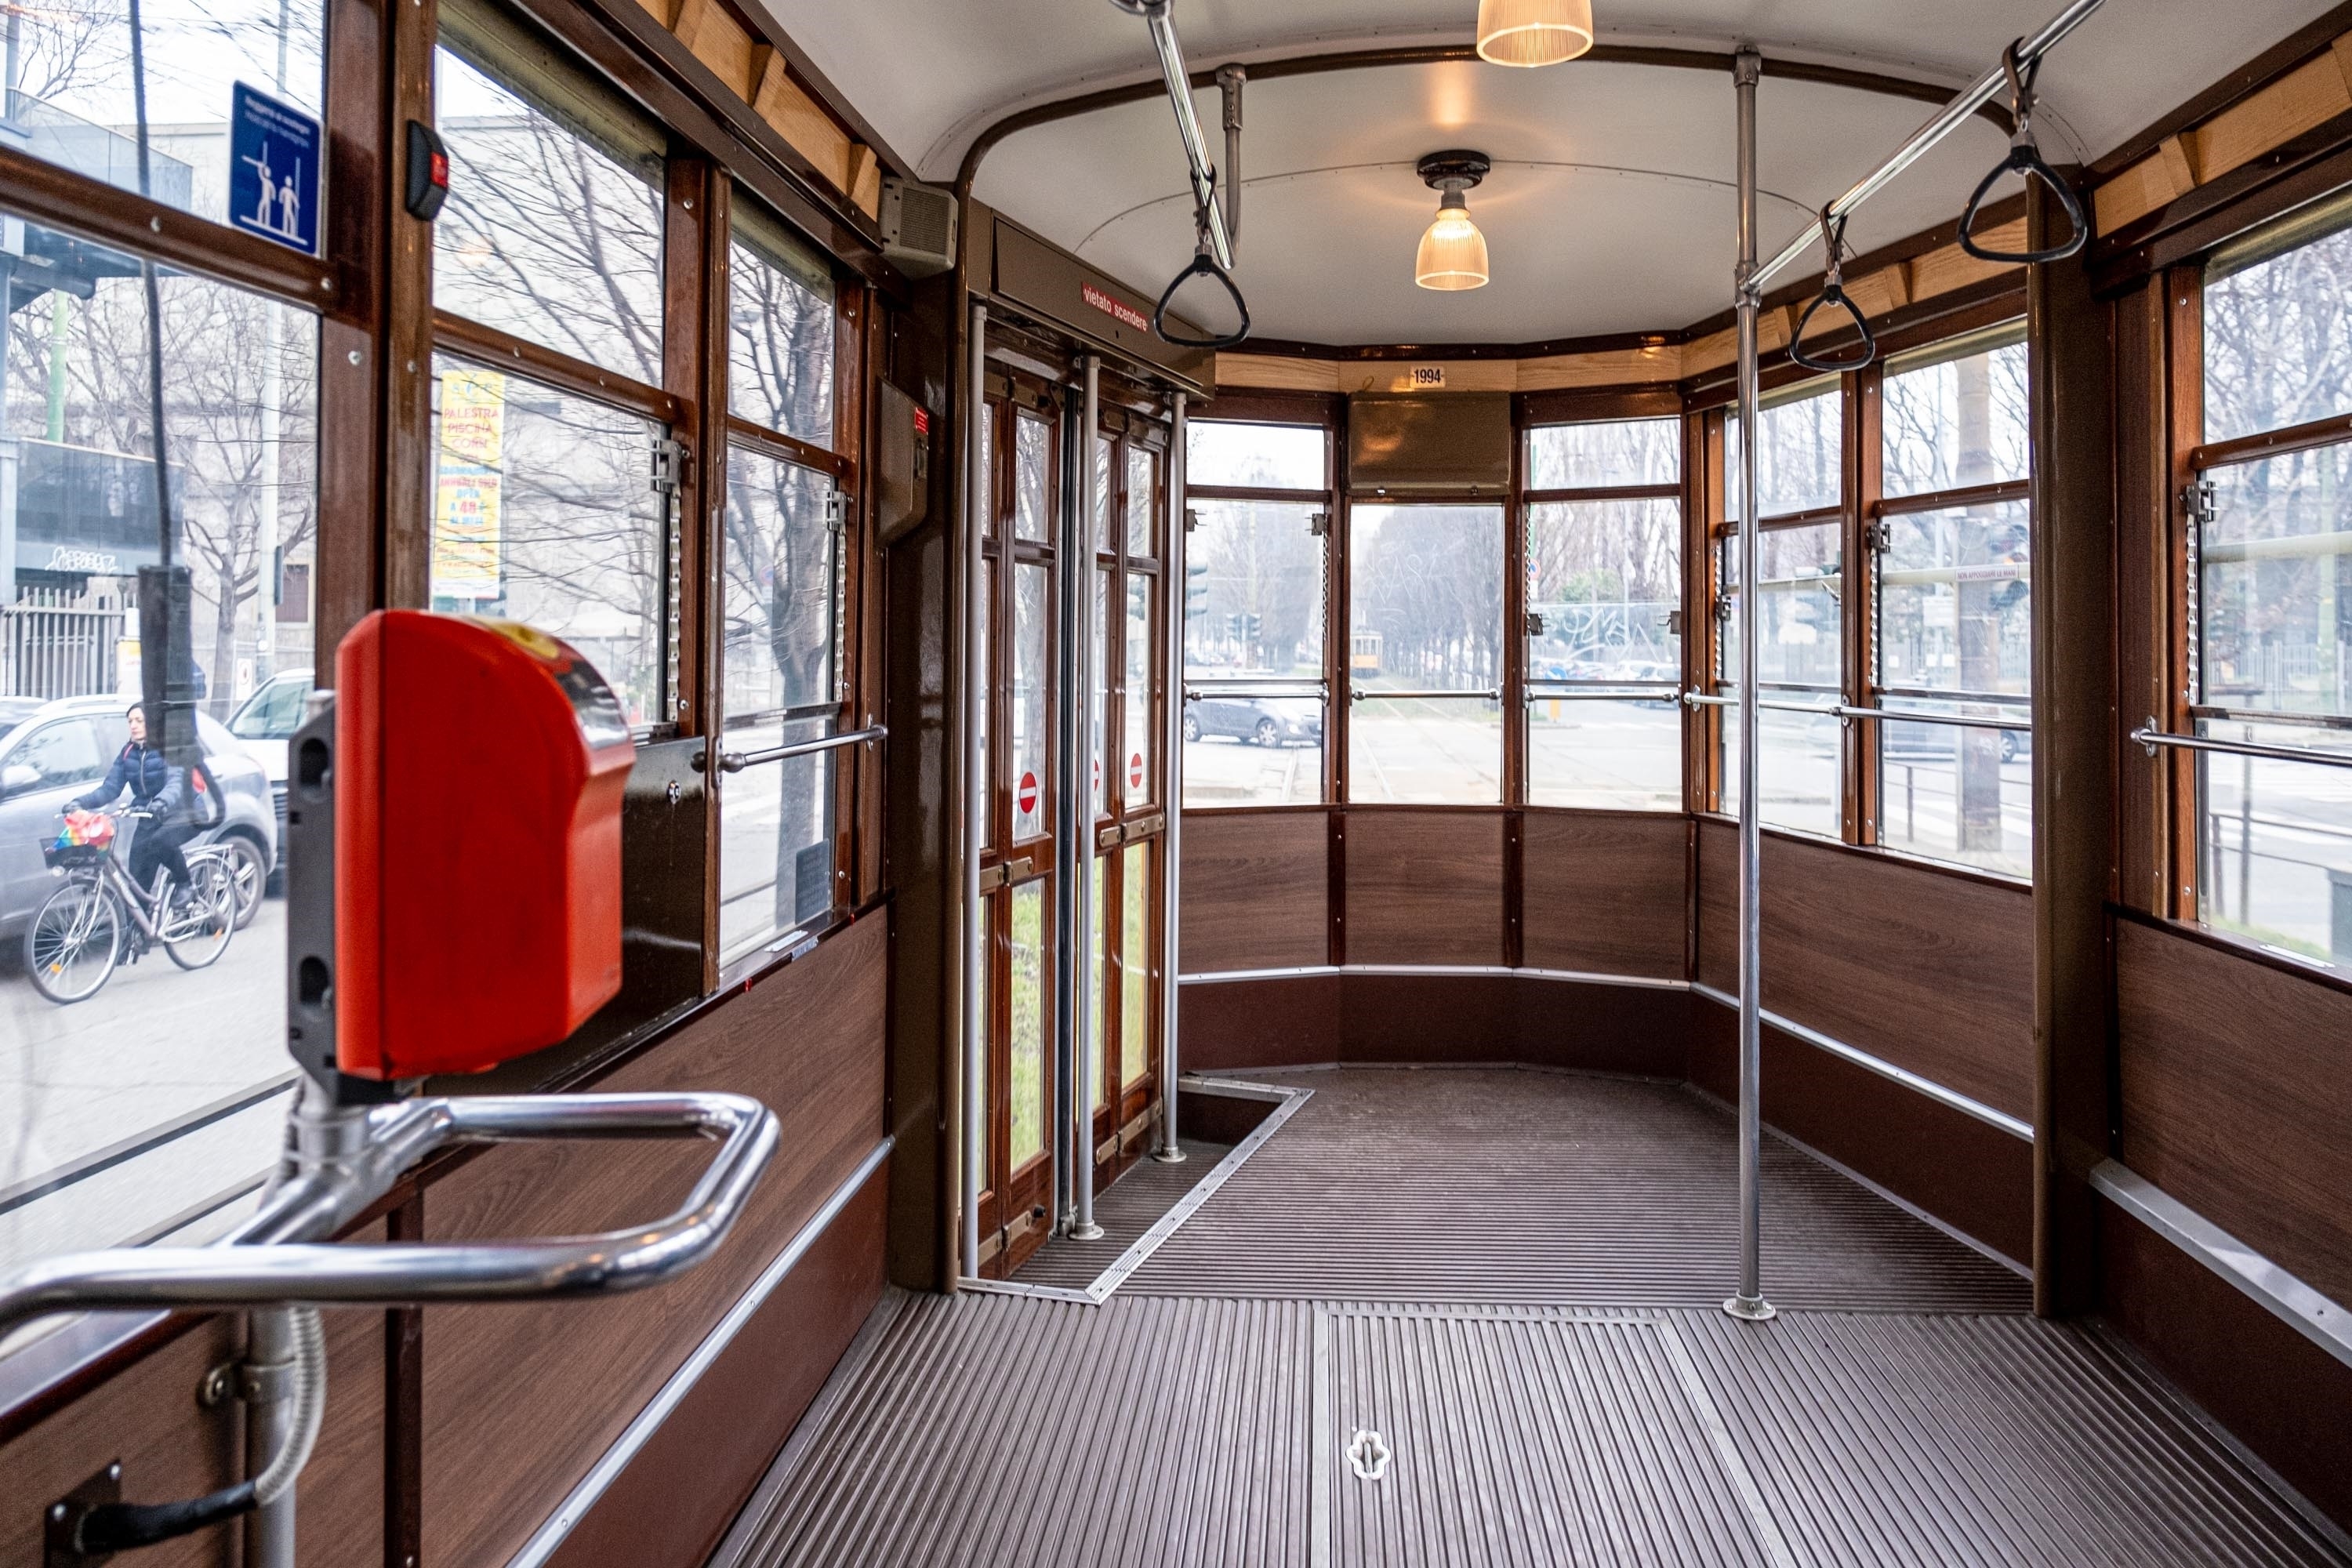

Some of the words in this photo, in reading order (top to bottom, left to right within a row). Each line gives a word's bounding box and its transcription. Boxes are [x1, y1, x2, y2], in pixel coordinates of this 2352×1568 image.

[1084, 287, 1112, 314] vietato
[1114, 303, 1147, 331] scendere
[1414, 368, 1441, 383] 1994
[444, 408, 499, 419] PALESTRA
[448, 423, 492, 434] PISCINA
